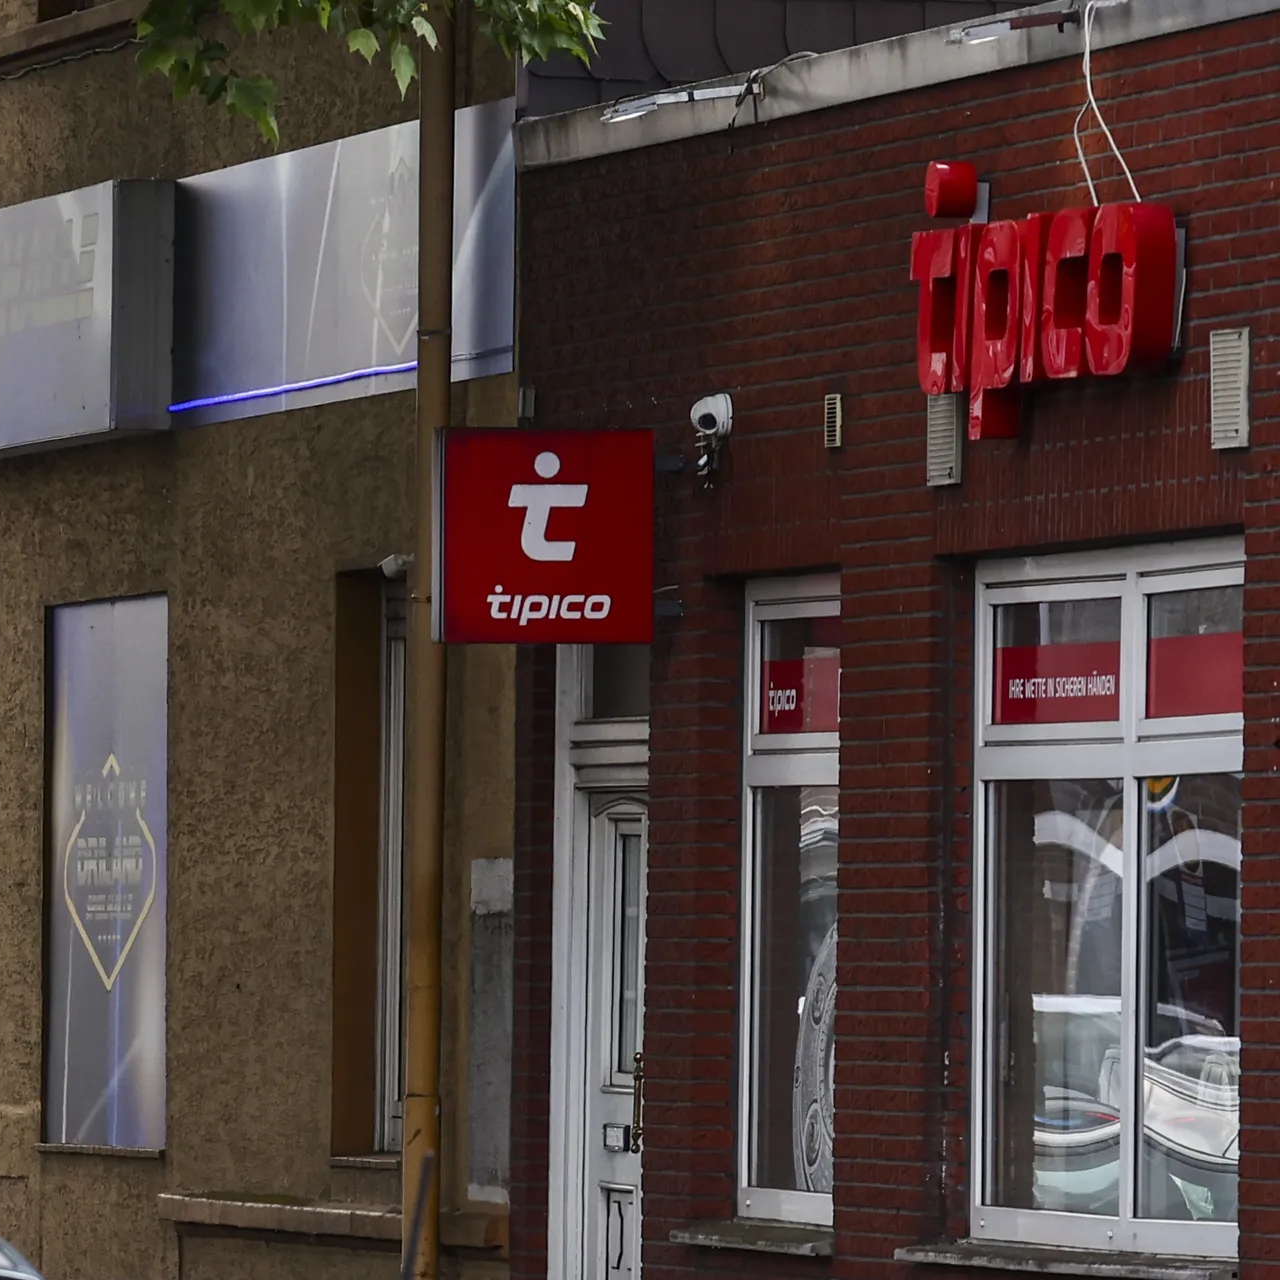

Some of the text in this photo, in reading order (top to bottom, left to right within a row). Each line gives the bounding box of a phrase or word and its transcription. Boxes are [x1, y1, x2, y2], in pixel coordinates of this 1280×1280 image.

[910, 160, 1177, 440] tipico
[486, 585, 612, 626] tipico
[768, 681, 797, 717] tipico
[1009, 679, 1024, 699] IHRE
[1025, 677, 1046, 699] WETTE
[1047, 677, 1055, 698] IN
[1055, 676, 1087, 698] SICHEREN
